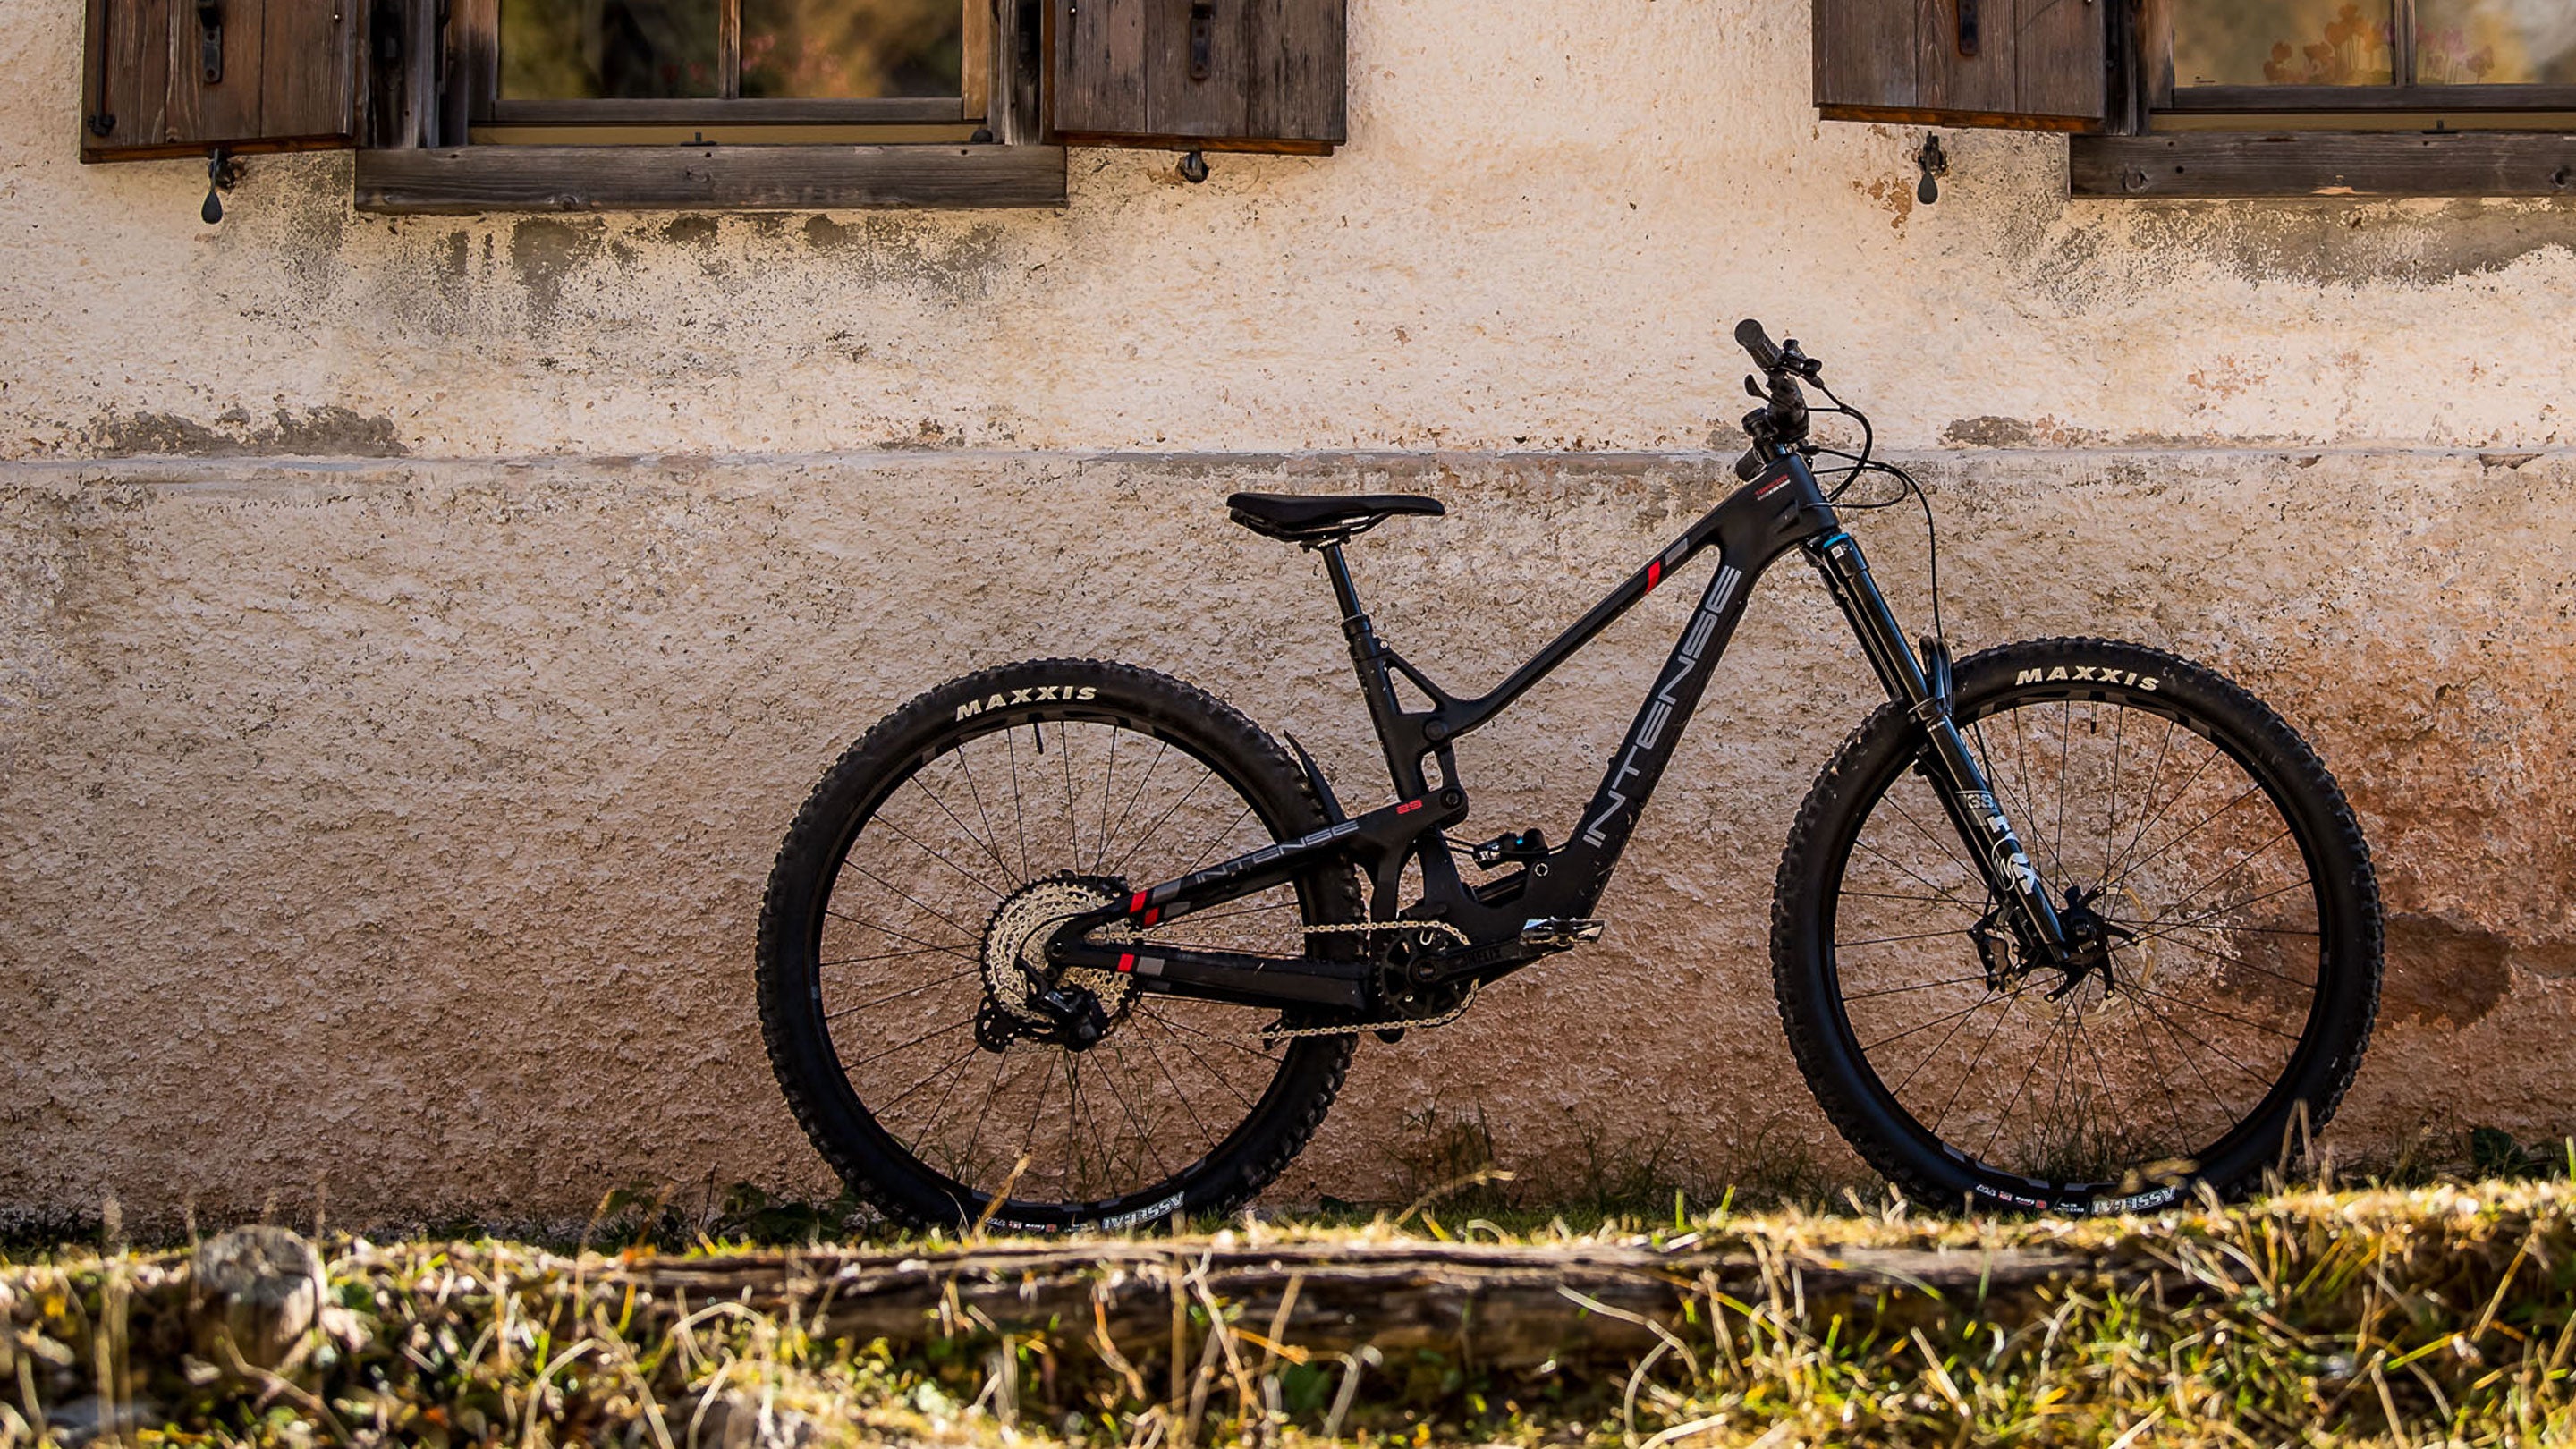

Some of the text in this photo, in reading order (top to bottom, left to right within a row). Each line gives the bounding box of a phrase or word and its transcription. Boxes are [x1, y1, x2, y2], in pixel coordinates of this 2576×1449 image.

[2015, 666, 2160, 691] MAXXIS
[955, 686, 1097, 722] MAXXIS
[1582, 565, 1741, 848] INTENSE
[1195, 820, 1359, 883] INTENSE
